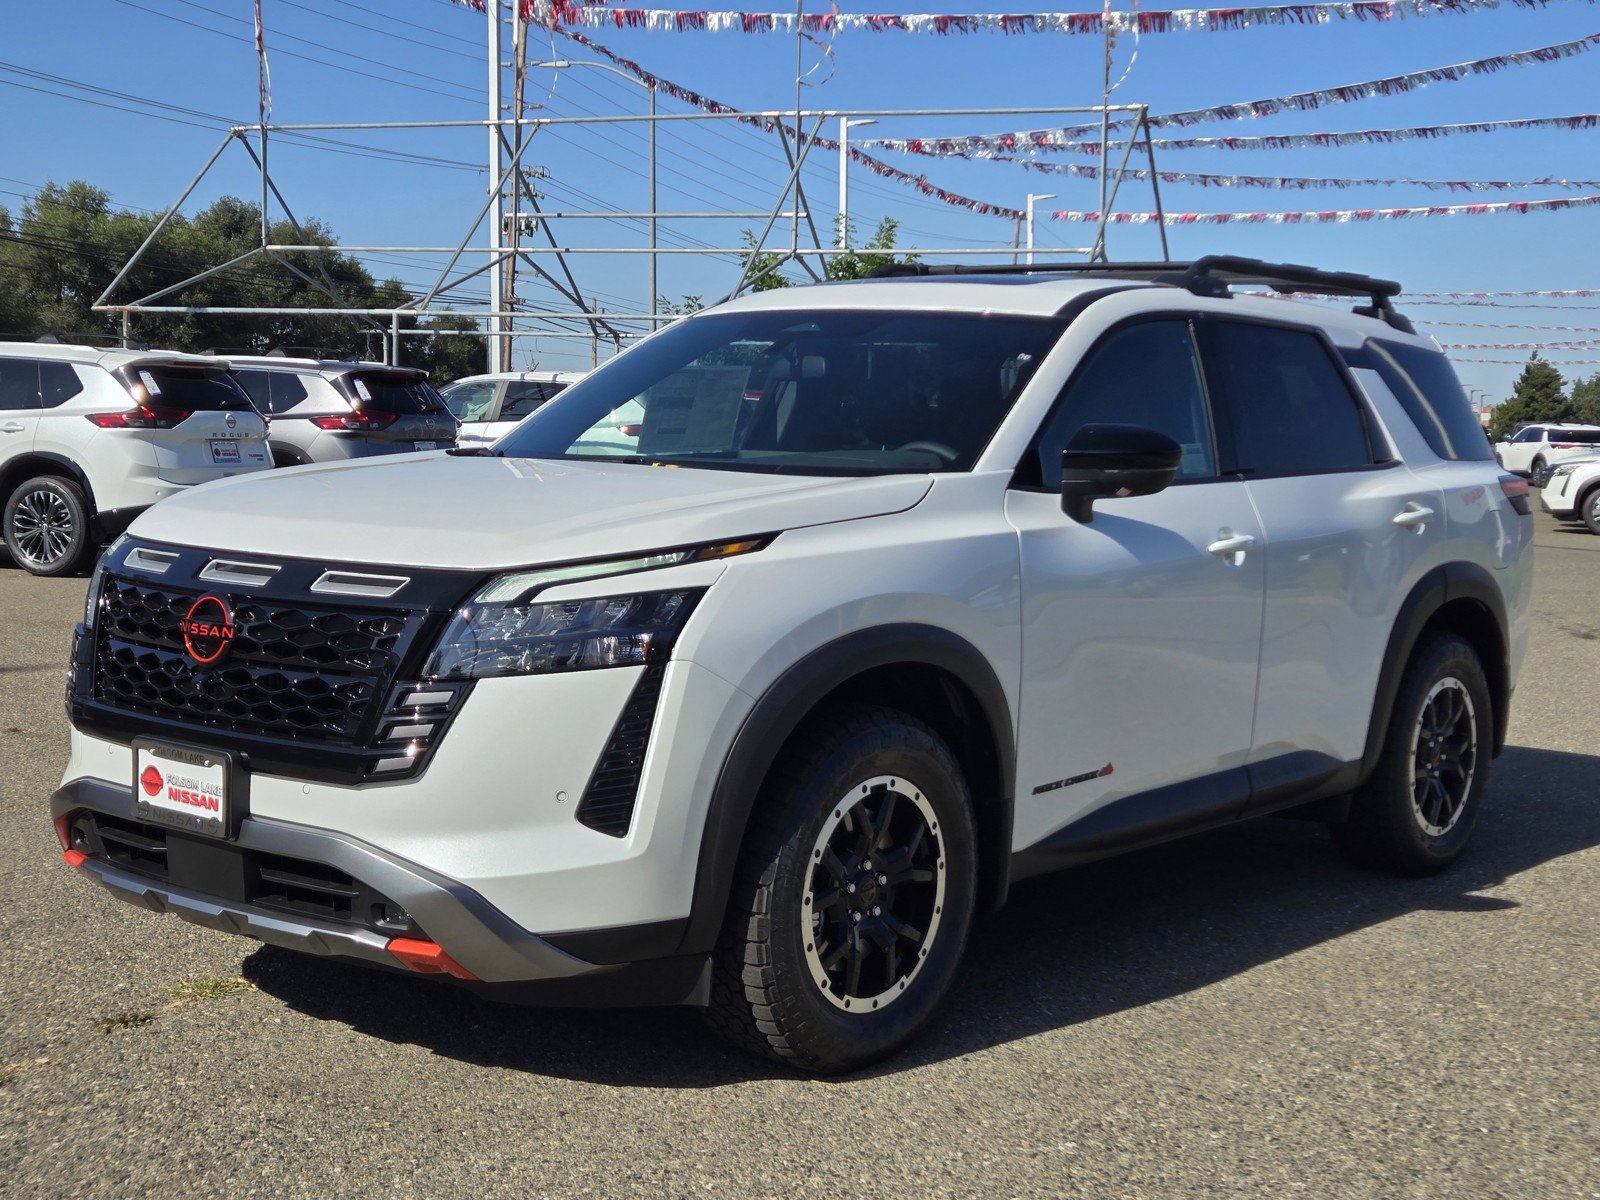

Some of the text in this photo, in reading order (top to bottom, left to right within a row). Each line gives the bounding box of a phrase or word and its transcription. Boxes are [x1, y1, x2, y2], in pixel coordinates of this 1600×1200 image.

[180, 620, 235, 639] NISSAN
[184, 752, 205, 764] LAKE
[166, 772, 223, 797] FOLSOM LAKE
[167, 786, 220, 812] NISSAN
[152, 807, 205, 831] NISSAN
